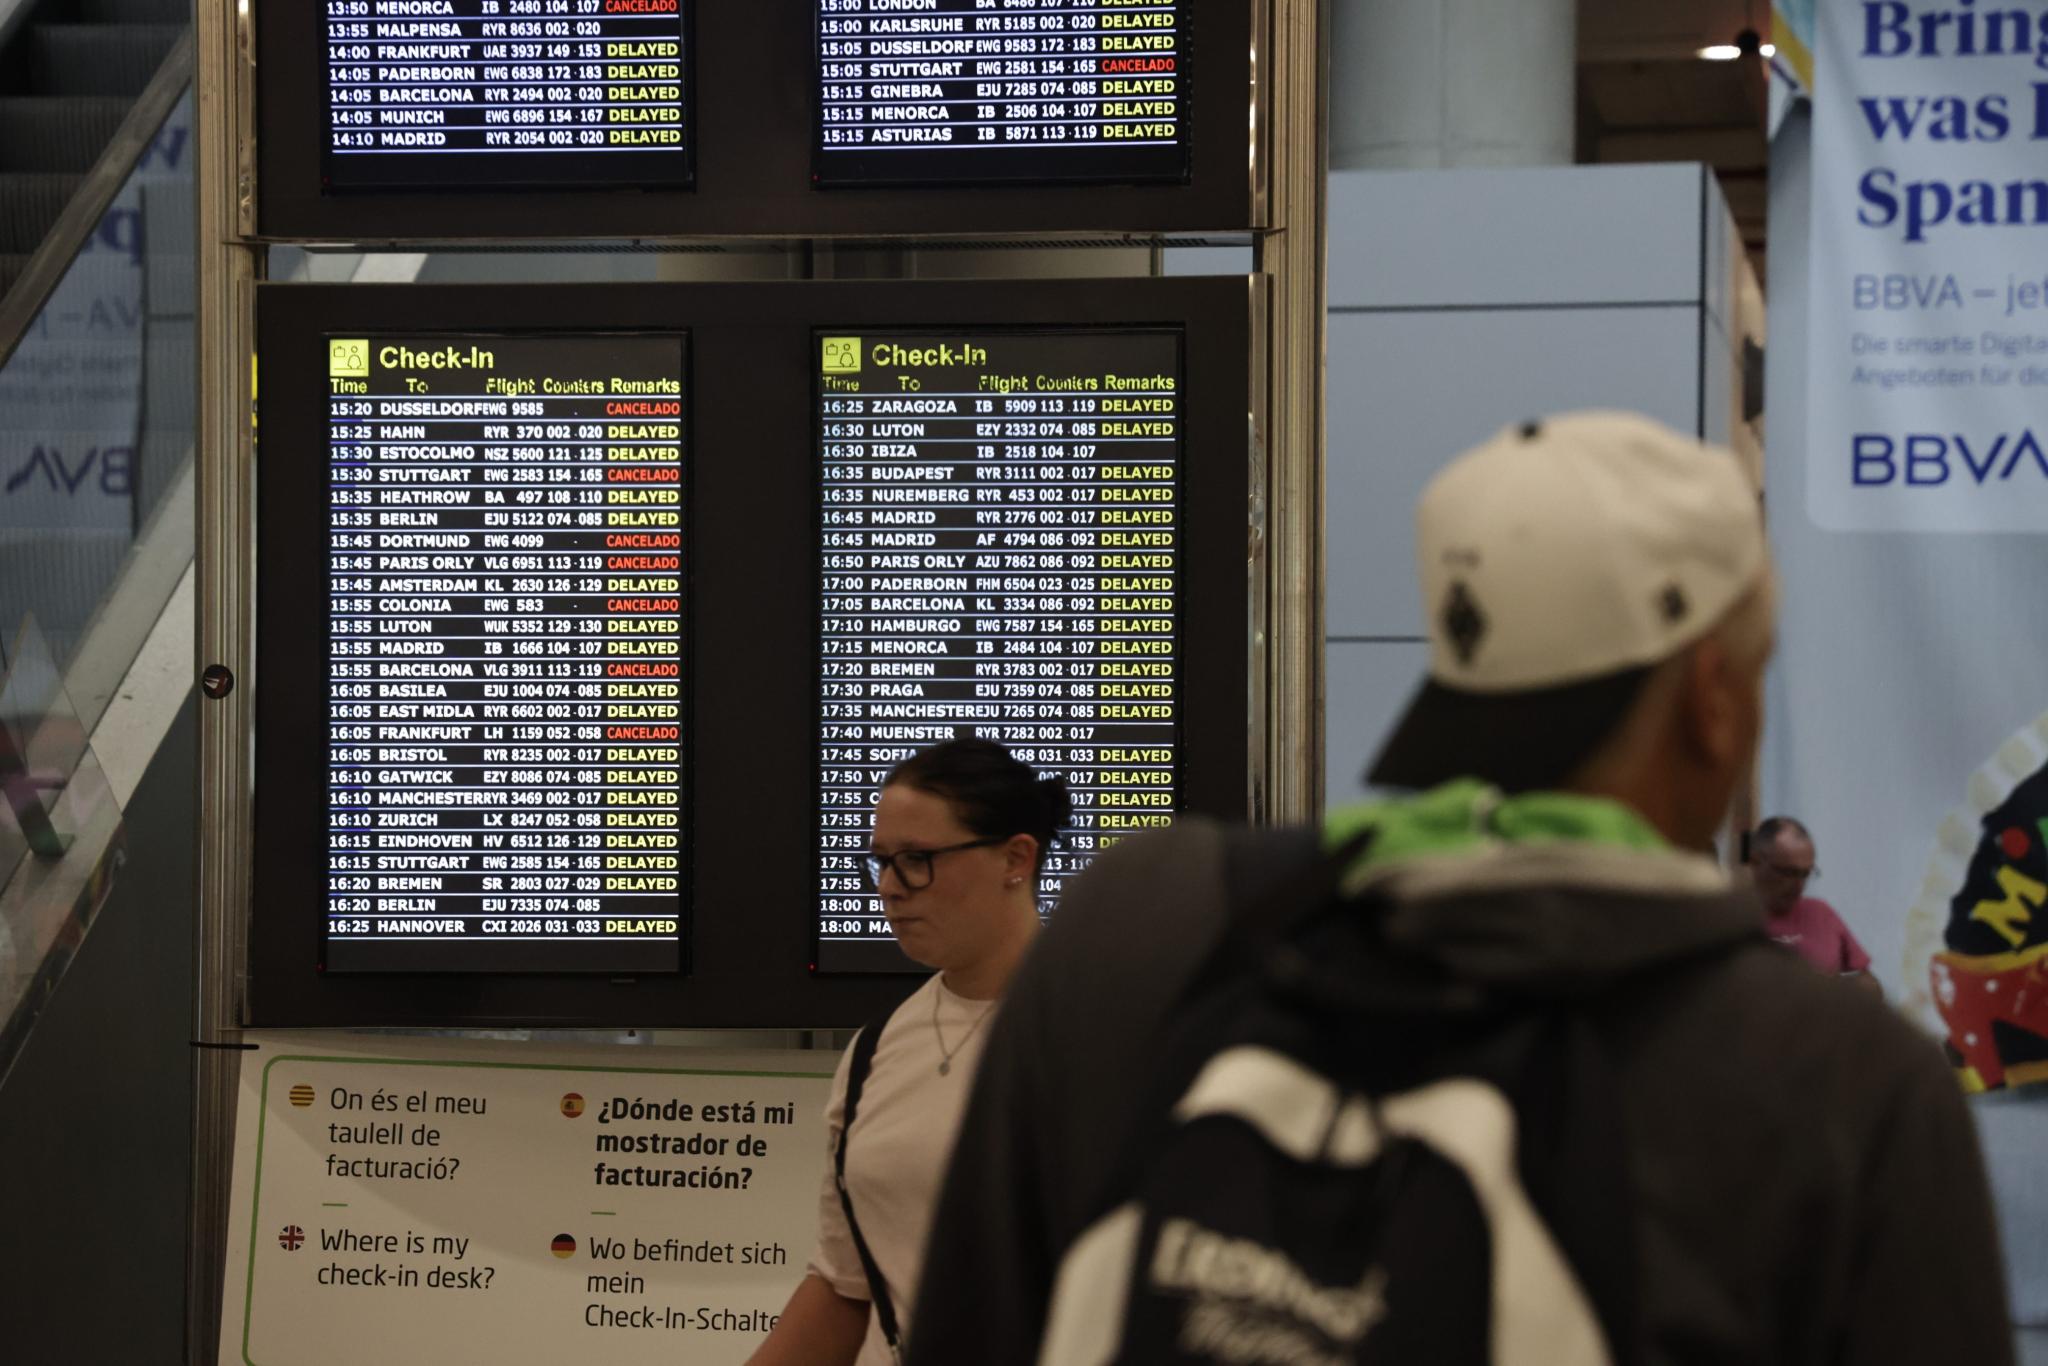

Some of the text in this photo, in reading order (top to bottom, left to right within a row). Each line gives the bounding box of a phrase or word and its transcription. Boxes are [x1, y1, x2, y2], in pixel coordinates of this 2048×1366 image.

[328, 0, 676, 15] 13:50 MENORCA CANCELADO
[328, 23, 462, 37] 13:55 MALPENSA
[822, 14, 1174, 33] 15:00 KARLSRUHE DELAYED
[330, 43, 678, 59] 14:00 FRANKFURT DELAYED
[330, 65, 678, 81] 14:05 PADERBORN DELAYED
[822, 59, 1174, 78] 15:05 STUTTGART CANCELADO
[331, 87, 679, 102] 14:05 BARCELONA DELAYED
[823, 80, 1174, 99] 15:15 GINEBRA DELAYED
[332, 108, 680, 124] 14:05 MUNICH DELAYED
[823, 102, 1174, 120] 15:15 MENORCA DELAYED
[1858, 95, 2010, 142] was
[333, 130, 680, 146] 14:10 MADRID DELAYED
[824, 124, 1175, 142] 15:15 ASTURIAS DELAYED
[1853, 274, 1963, 310] BBVA
[380, 346, 493, 368] Check-In
[873, 344, 986, 366] Check-In
[330, 378, 680, 396] Time To Flight Counters Remarks
[823, 375, 1174, 393] Time To Flight Counters Remarks
[824, 400, 1173, 413] 16:25 ZARAGOZA DELAYED
[332, 426, 678, 438] 15:25 HAHN DELAYED
[824, 423, 1173, 436] 16:30 LUTON DELAYED
[332, 446, 678, 460] 15:30 ESTOCOLMO DELAYED
[824, 445, 917, 457] 16:30 IBIZA
[1851, 428, 2048, 487] BBVA
[332, 468, 679, 482] 15:30 STUTTGART CANCELADO
[824, 466, 1173, 480] 16:35 BUDAPEST DELAYED
[332, 490, 678, 504] 15:35 HEATHROW DELAYED
[872, 489, 969, 502] NUREMBERG
[332, 512, 678, 526] 15:35 BERLIN DELAYED
[872, 512, 936, 524] MADRID
[380, 535, 680, 548] DORTMUND CANCELADO
[380, 556, 678, 569] PARIS ORLY CANCELADO
[380, 579, 678, 592] AMSTERDAM DELAYED
[872, 578, 967, 590] PADERBORN
[379, 599, 678, 612] COLONIA CANCELADO
[871, 598, 964, 610] BARCELONA
[380, 620, 432, 633] LUTON
[871, 619, 960, 632] HAMBURGO
[380, 642, 444, 654] MADRID
[871, 641, 948, 654] MENORCA
[380, 664, 473, 676] BARCELONA
[871, 663, 934, 675] BREMEN
[380, 684, 447, 697] BASILEA
[871, 684, 924, 696] PRAGA
[380, 705, 474, 718] EAST MIDLA
[379, 727, 678, 739] FRANKFURT CANCELADO
[870, 726, 954, 739] MUENSTER
[379, 748, 447, 761] BRISTOL
[378, 770, 453, 783] GATWICK
[378, 814, 438, 826] ZURICH
[379, 835, 472, 847] EINDHOVEN
[378, 856, 469, 869] STUTTGART
[330, 878, 676, 890] 16:20 BREMEN DELAYED
[330, 899, 435, 911] 16:20 BERLIN
[821, 899, 861, 911] 18:00
[329, 920, 676, 932] 16:25 HANNOVER DELAYED
[821, 921, 861, 933] 18:00
[331, 1088, 486, 1114] On és el meu
[598, 1098, 794, 1124] ¿Dónde está mi
[328, 1122, 440, 1146] taulell de
[596, 1133, 767, 1156] mostrador de
[326, 1154, 460, 1180] facturació?
[594, 1163, 752, 1189] facturación?
[321, 1229, 469, 1260] Where is my
[590, 1237, 786, 1264] Wo befindet sich
[318, 1262, 495, 1289] check-in desk?
[588, 1272, 644, 1294] mein
